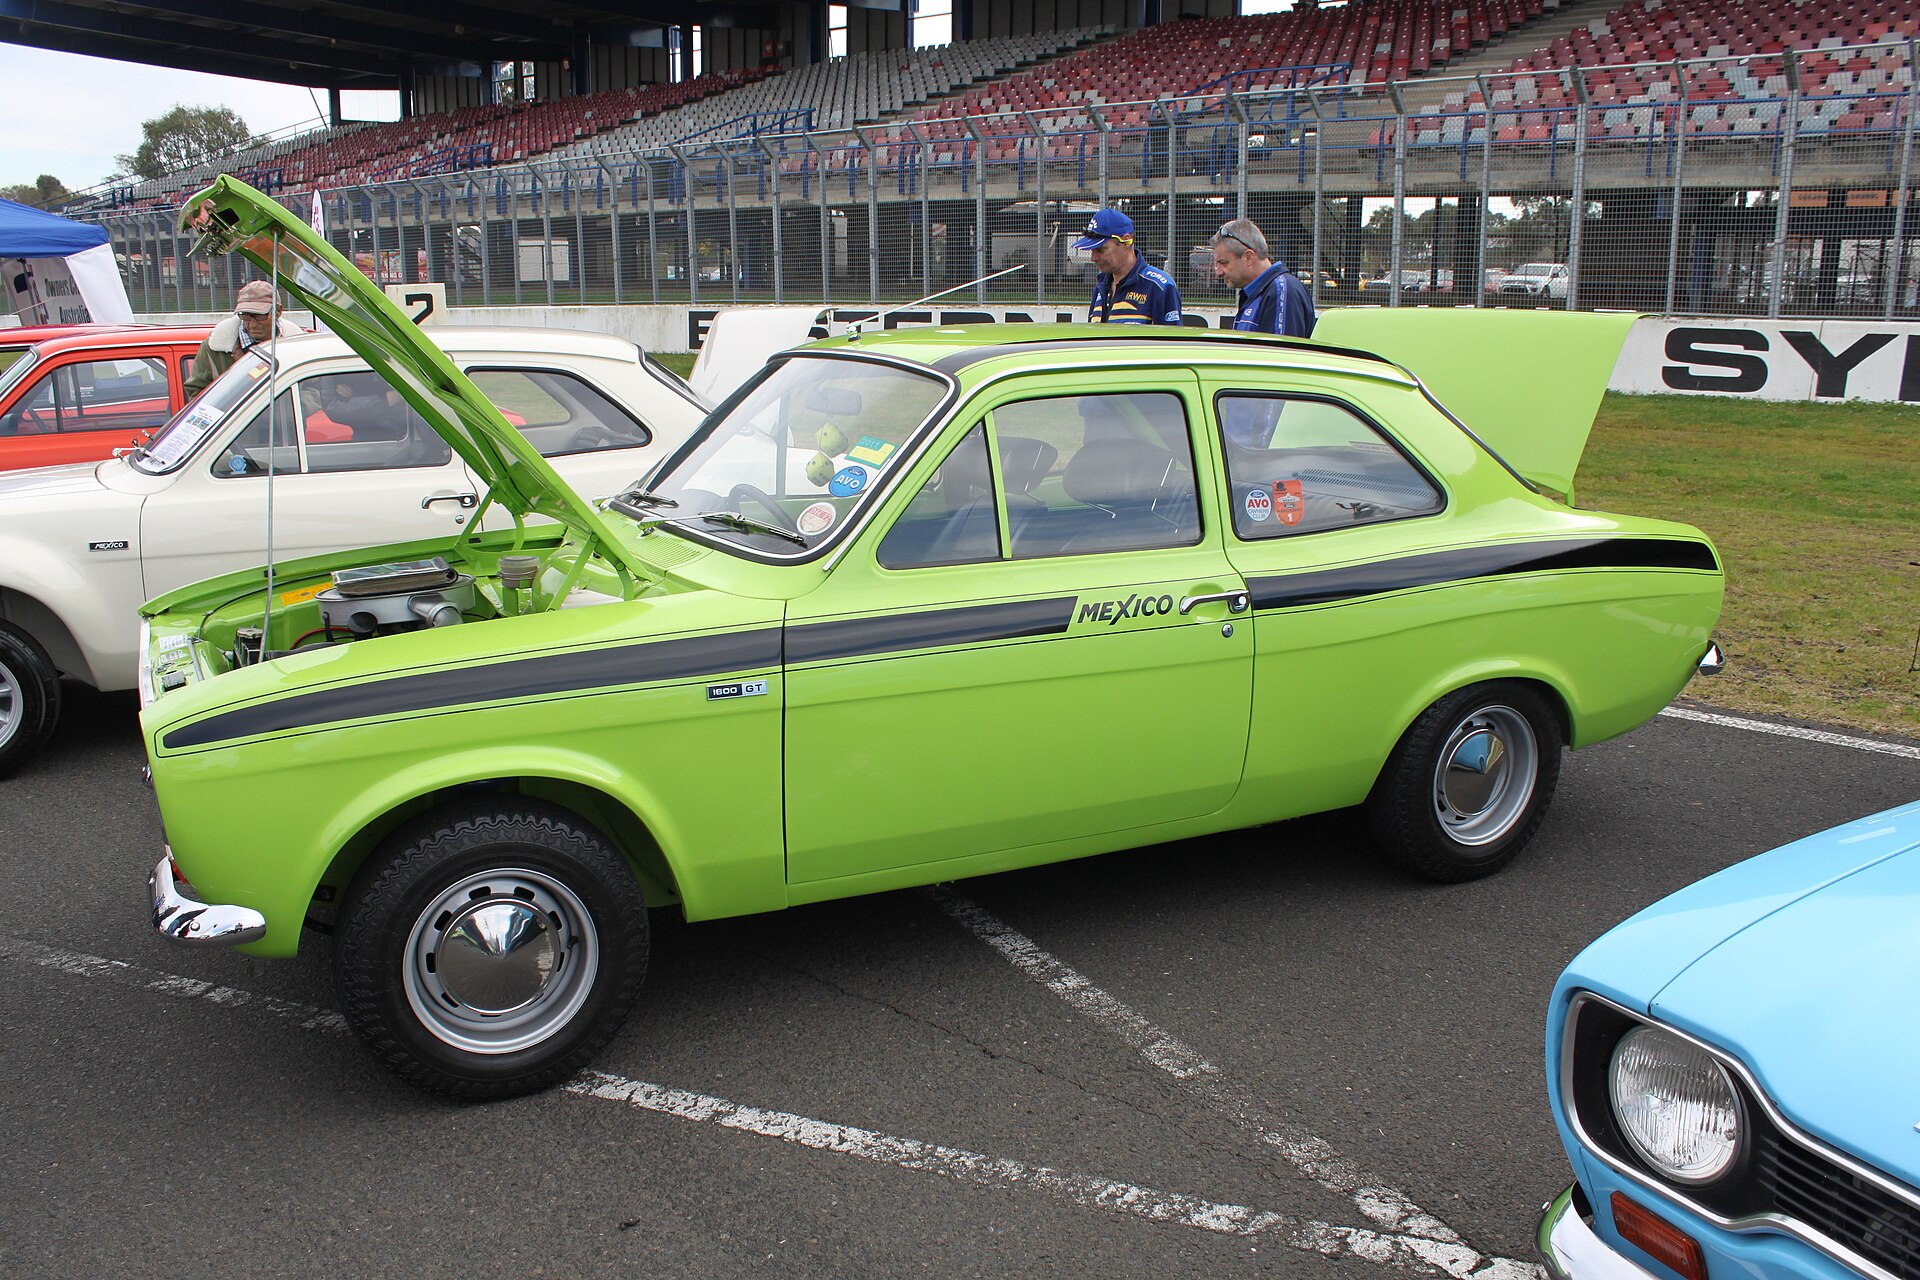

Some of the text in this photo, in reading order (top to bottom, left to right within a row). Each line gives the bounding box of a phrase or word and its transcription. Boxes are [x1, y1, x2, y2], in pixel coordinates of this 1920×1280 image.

[1146, 270, 1168, 284] FORD
[1125, 291, 1148, 302] IRWIN
[835, 474, 860, 488] AVO
[1247, 499, 1269, 508] AVO
[95, 541, 124, 549] MEXICO
[1077, 594, 1174, 626] MEXICO
[712, 684, 763, 696] 1600 GT
